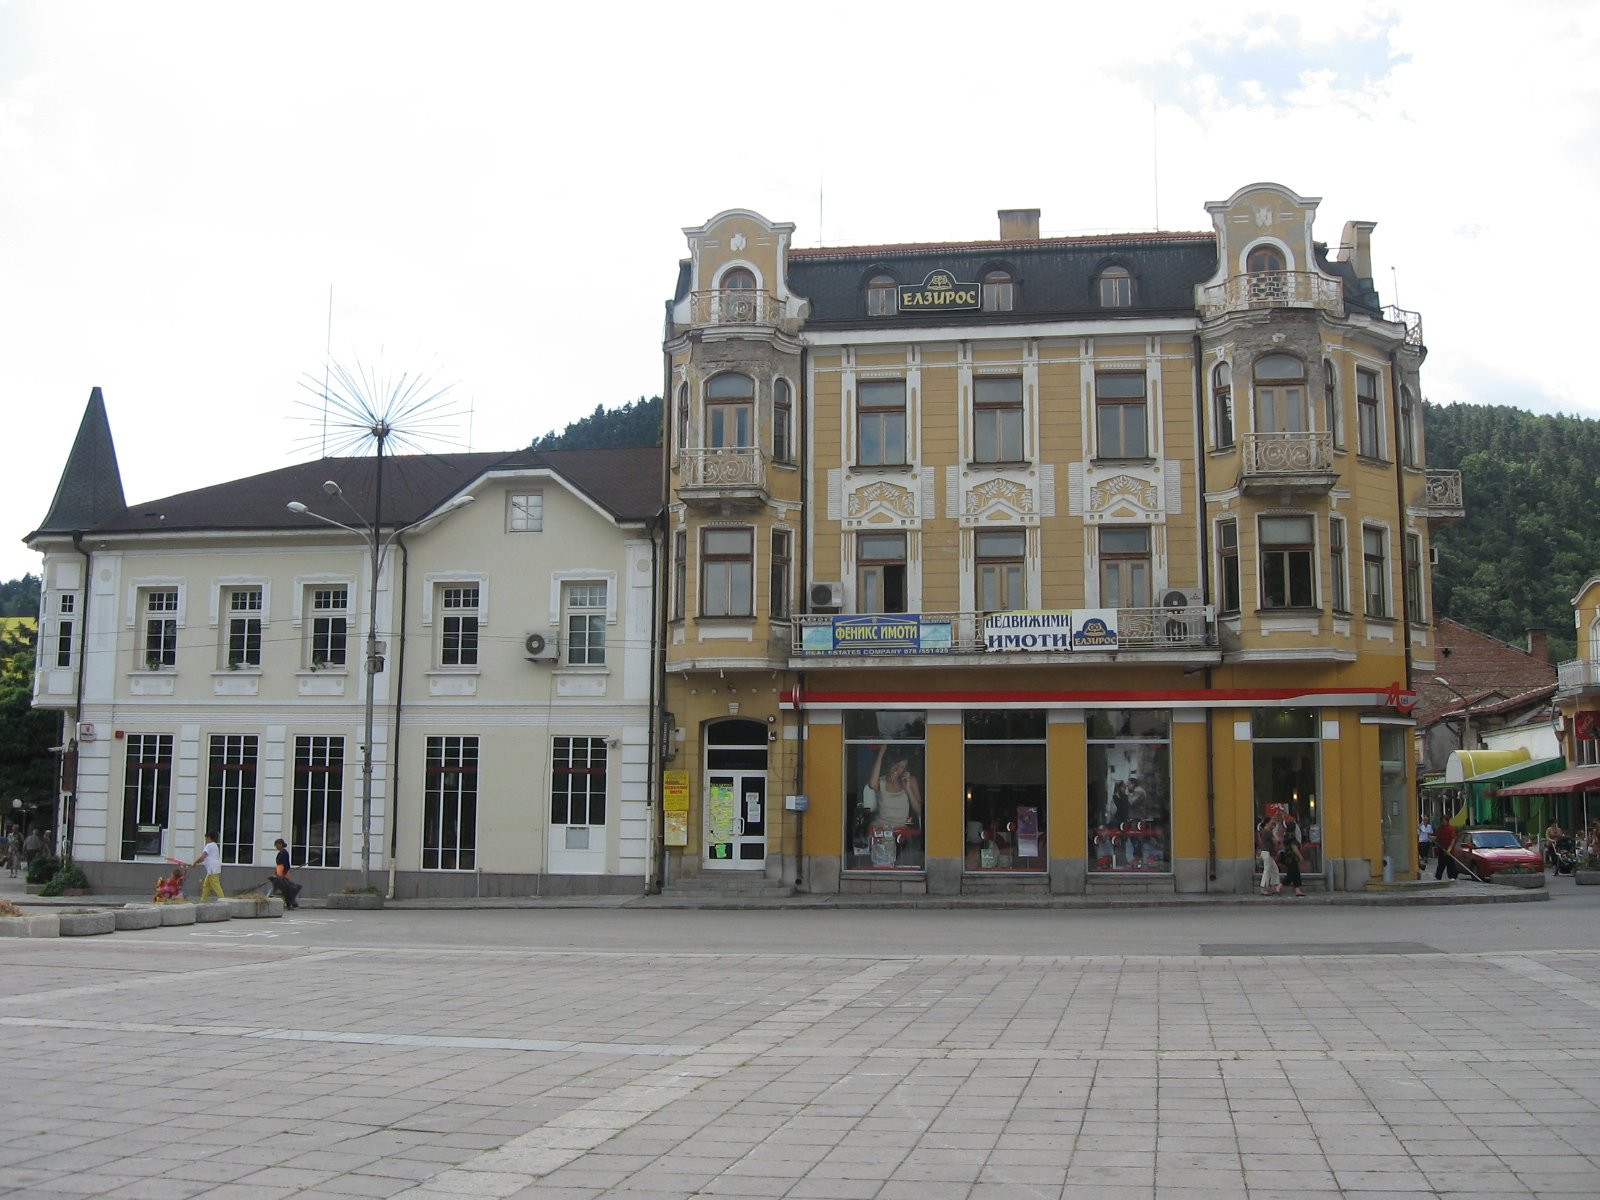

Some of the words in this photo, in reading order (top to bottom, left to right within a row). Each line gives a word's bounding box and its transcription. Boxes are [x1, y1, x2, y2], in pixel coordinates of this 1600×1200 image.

[902, 291, 976, 305] ЕЛЗИРОС
[986, 614, 1069, 628] НЕДВИЖИМИ
[835, 625, 878, 640] ФЕНИКС
[880, 625, 918, 639] ИМОТИ
[988, 633, 1067, 648] ИМОТИ
[1075, 636, 1117, 646] ЕЛЗИРОС
[863, 648, 902, 656] COMPANY
